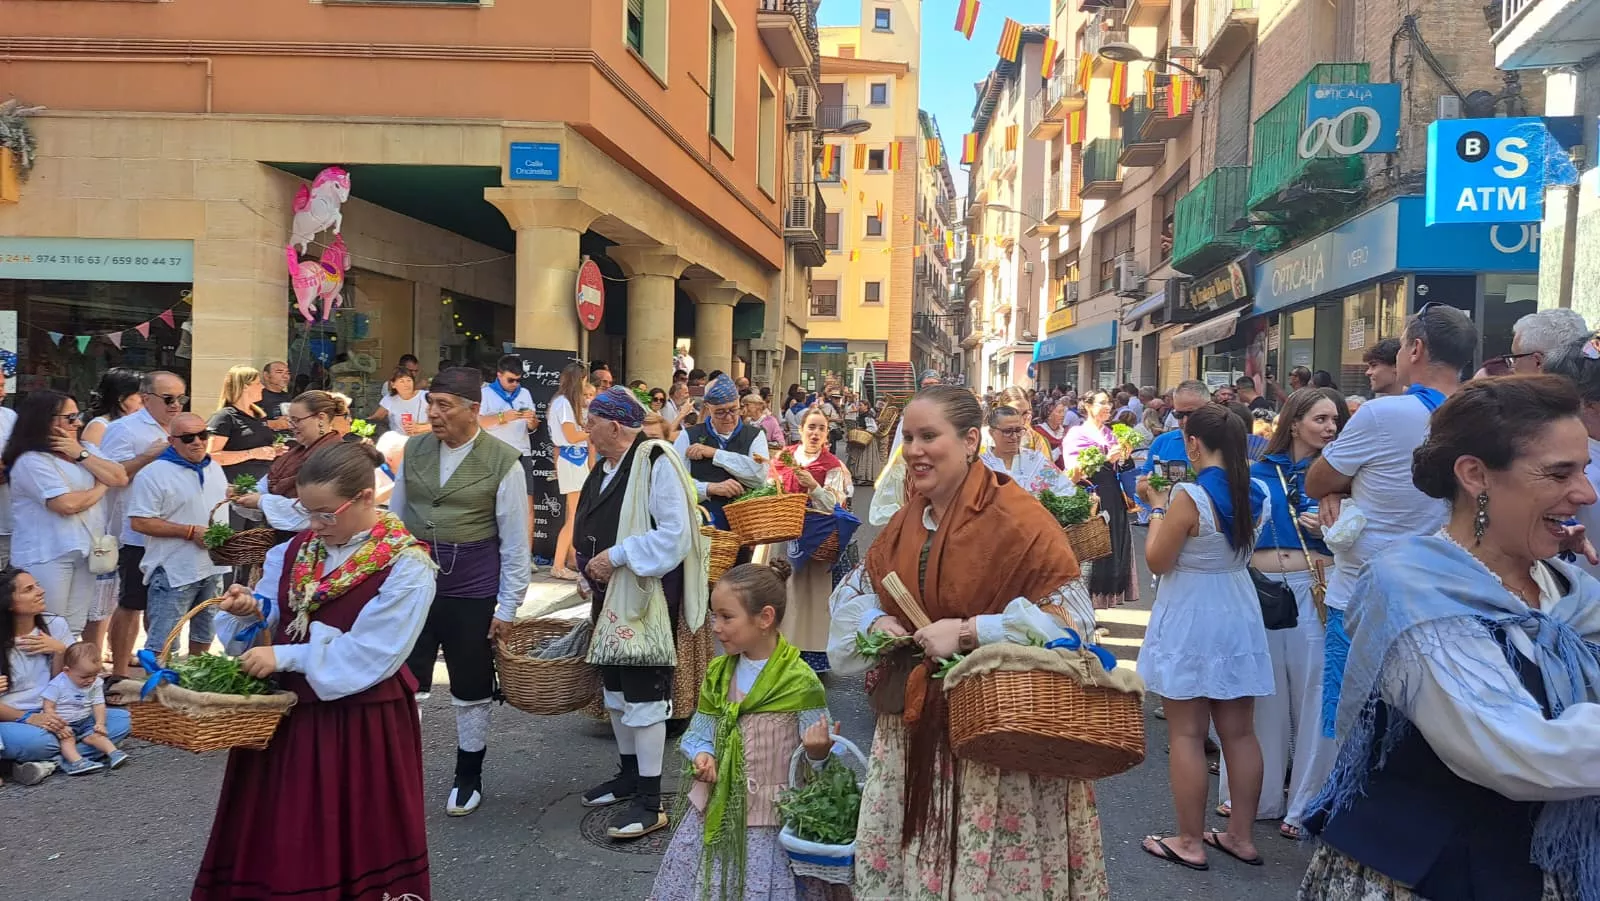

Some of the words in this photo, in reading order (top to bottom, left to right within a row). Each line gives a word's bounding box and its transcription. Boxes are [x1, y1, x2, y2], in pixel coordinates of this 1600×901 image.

[524, 159, 544, 167] Calle
[1464, 138, 1482, 156] B
[1493, 136, 1529, 179] S
[1456, 186, 1527, 212] ATM
[36, 255, 57, 263] 974
[59, 255, 70, 264] 31
[74, 256, 84, 264] 16
[87, 256, 101, 264] 63
[112, 256, 132, 265] 659
[135, 257, 149, 265] 80
[152, 257, 166, 265] 44
[169, 257, 182, 266] 37
[532, 469, 555, 477] ONES
